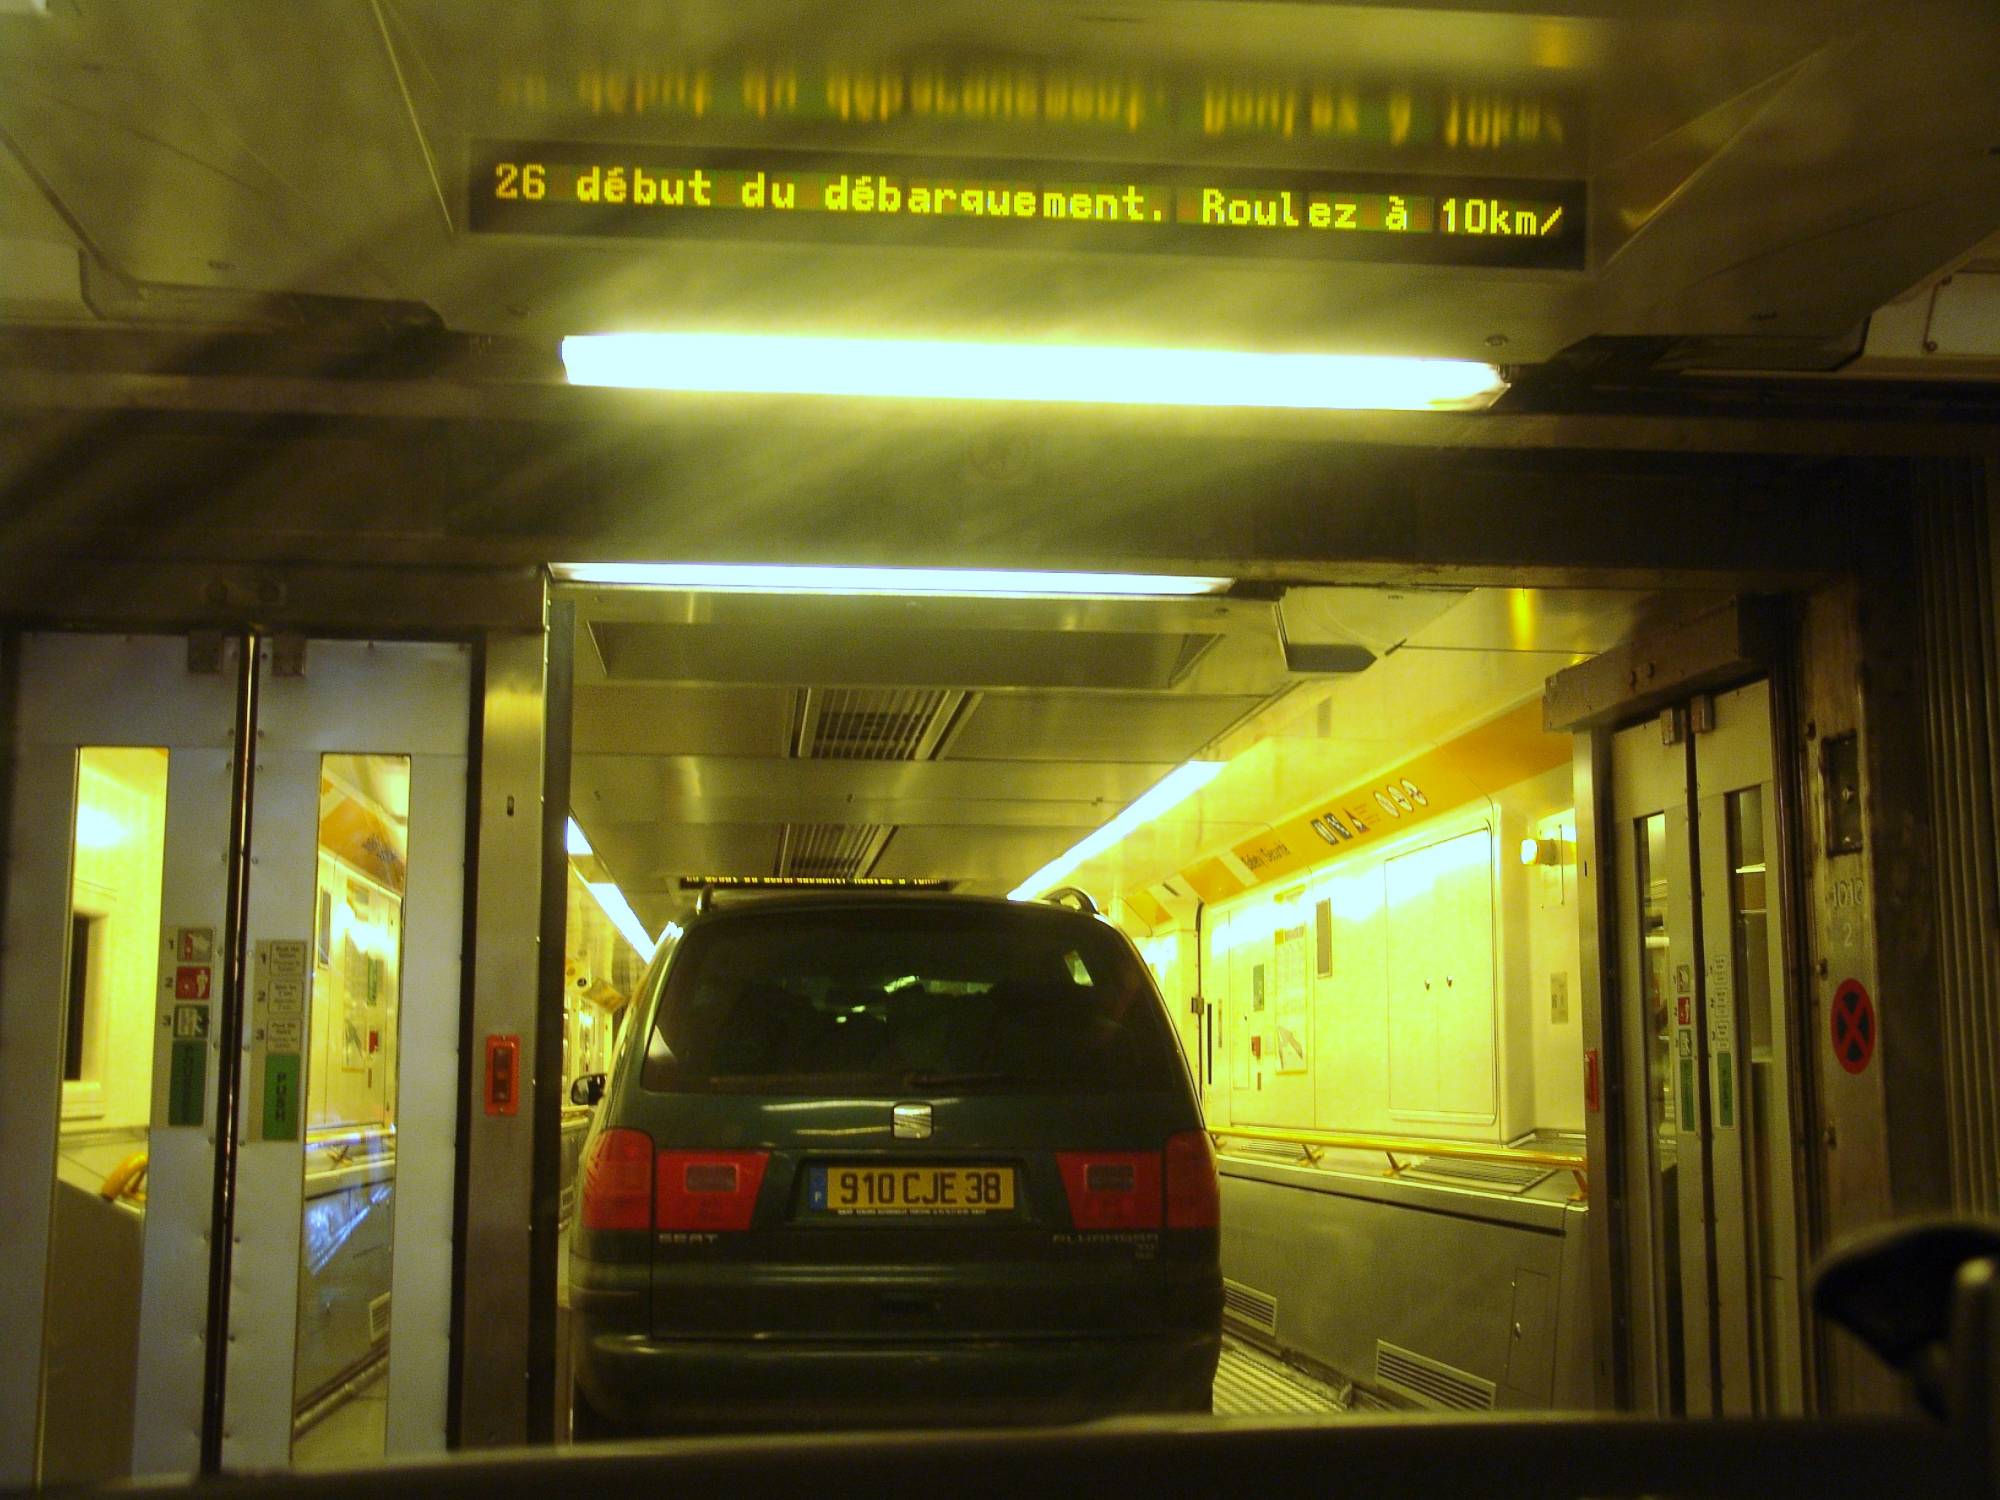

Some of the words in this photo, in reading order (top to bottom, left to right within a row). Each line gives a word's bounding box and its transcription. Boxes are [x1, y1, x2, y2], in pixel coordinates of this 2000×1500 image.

[495, 163, 546, 200] 26
[576, 166, 712, 207] début
[741, 171, 796, 210] du
[824, 174, 1165, 223] débarquement.
[1202, 187, 1358, 230] Roulez
[1384, 195, 1408, 232] à
[1442, 198, 1563, 236] 10km/
[1842, 922, 1853, 947] 2
[840, 1172, 896, 1205] 910
[902, 1172, 958, 1205] CJE
[965, 1172, 1002, 1205] 38
